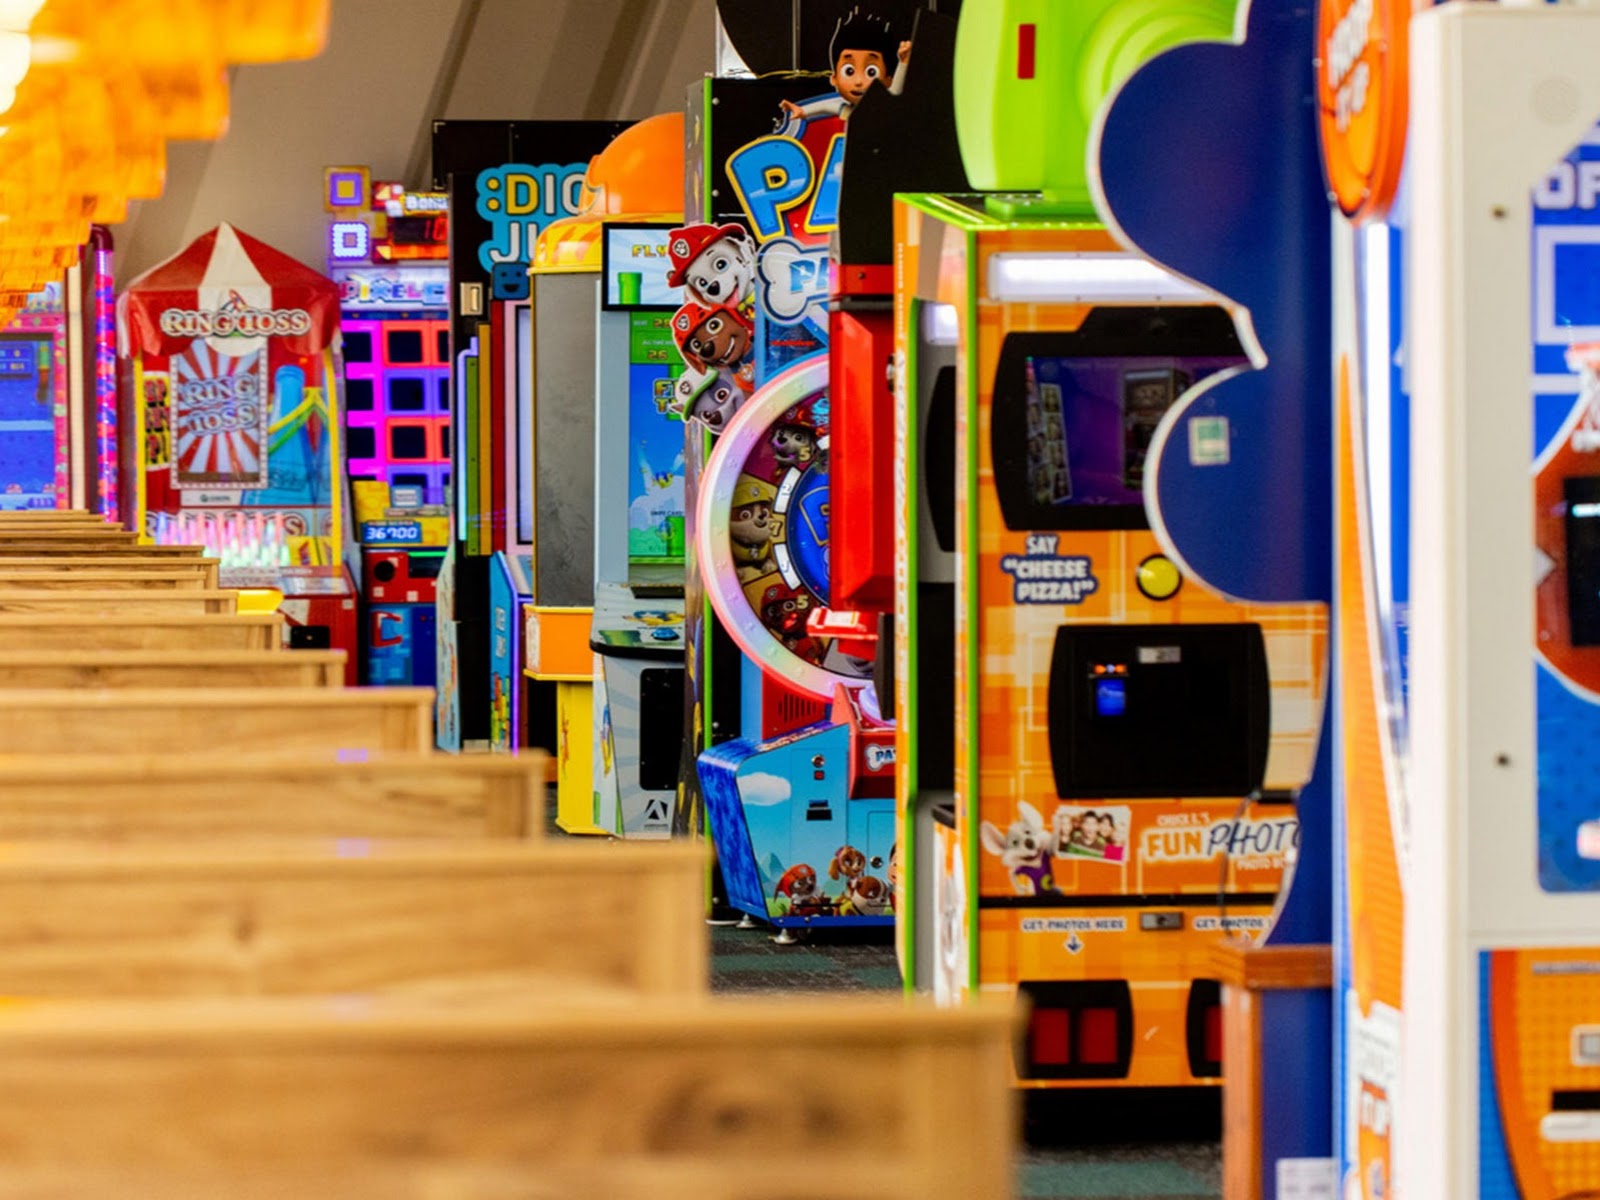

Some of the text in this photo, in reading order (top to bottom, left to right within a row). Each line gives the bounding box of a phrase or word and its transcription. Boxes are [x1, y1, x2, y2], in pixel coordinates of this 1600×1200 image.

[162, 310, 309, 336] RING TOSS
[182, 375, 257, 407] RING
[187, 403, 258, 434] TOSS
[1027, 536, 1058, 555] SAY
[1147, 830, 1203, 857] FUN
